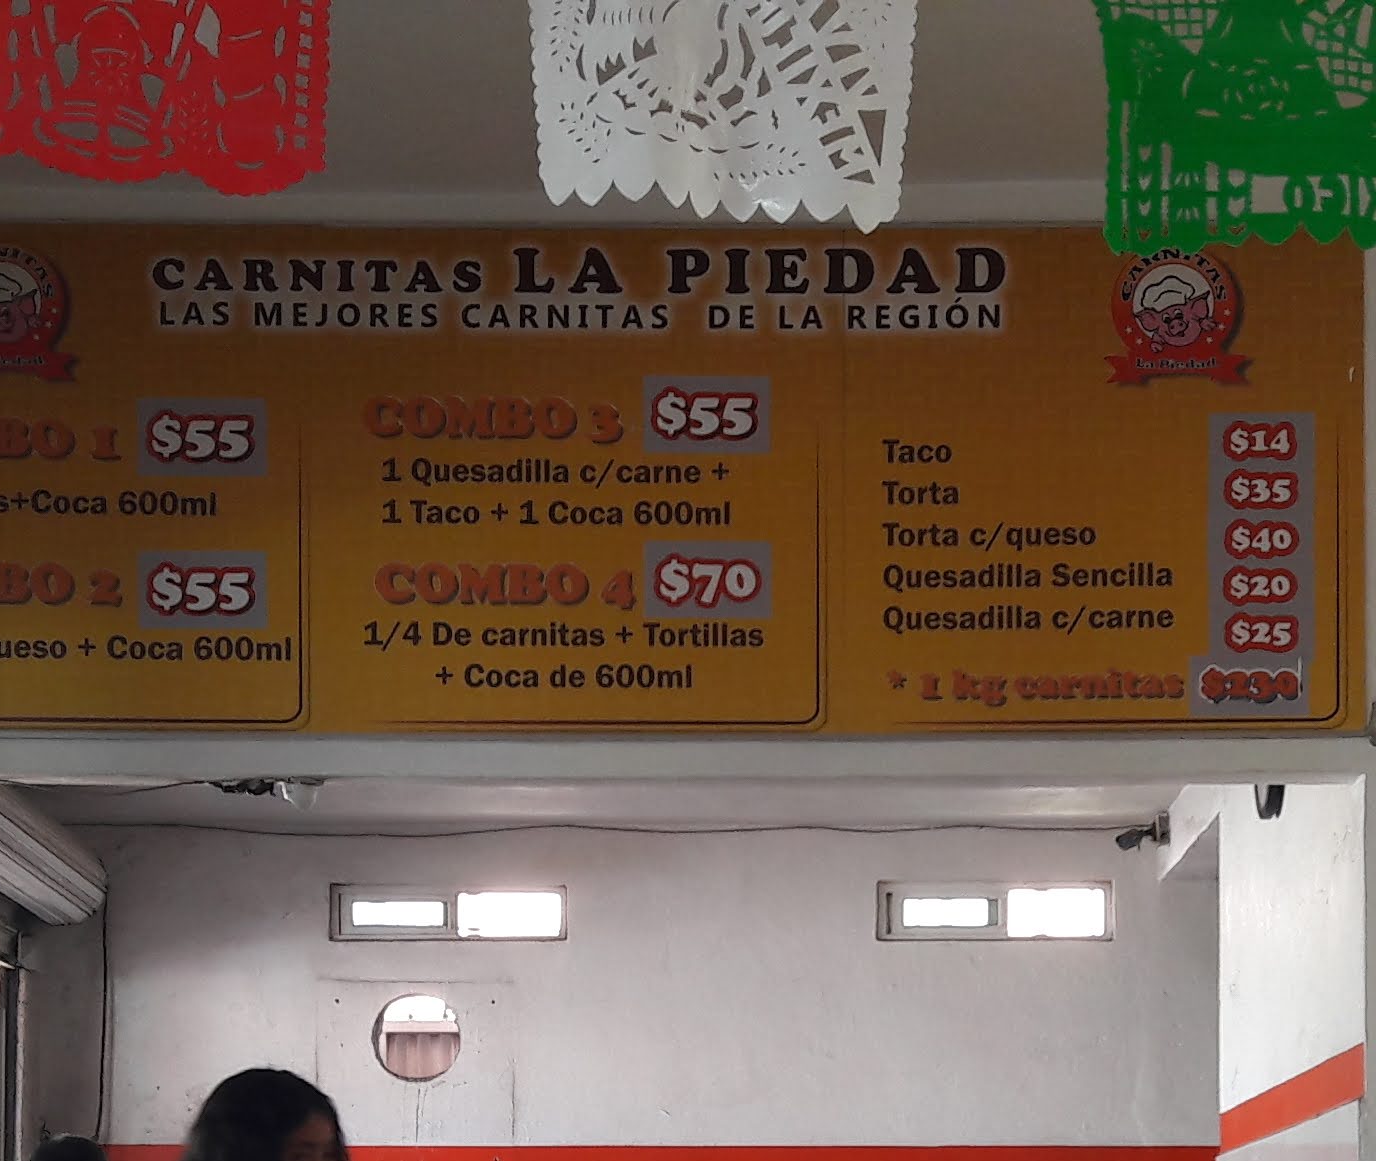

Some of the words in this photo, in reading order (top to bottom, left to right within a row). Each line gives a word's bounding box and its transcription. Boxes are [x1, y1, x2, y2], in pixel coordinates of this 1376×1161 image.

[152, 257, 484, 293] CARNITAS
[514, 248, 623, 294] LA
[667, 247, 1007, 296] PIEDAD
[159, 300, 231, 328] LAS
[253, 301, 440, 329] MEJORES
[461, 302, 670, 330] CARNITAS
[708, 303, 757, 330] DE
[779, 303, 823, 330] LA
[847, 296, 1003, 330] REGIÓN
[362, 396, 578, 440] COMBO
[589, 402, 625, 444] 3
[655, 389, 758, 439] $55
[90, 425, 123, 463] 1
[149, 411, 254, 461] $55
[882, 438, 953, 464] Taco
[1229, 426, 1291, 455] $14
[381, 457, 402, 482] 1
[411, 456, 570, 485] Quesadilla
[579, 459, 702, 489] c/carne
[882, 480, 960, 506] Torta
[1230, 474, 1292, 504] $35
[117, 491, 217, 517] 600ml
[381, 499, 402, 524] 1
[409, 499, 481, 525] Taco
[519, 500, 540, 525] 1
[548, 500, 624, 526] Coca
[633, 500, 732, 527] 600ml
[882, 522, 960, 548] Torta
[968, 521, 1097, 553] c/queso
[1230, 524, 1293, 554] $40
[88, 569, 123, 608] 2
[149, 564, 254, 614] $55
[374, 562, 590, 606] COMBO
[601, 568, 637, 610] 4
[658, 556, 758, 605] $70
[882, 563, 1042, 592] Quesadilla
[1051, 562, 1174, 589] Sencilla
[1229, 571, 1291, 600] $20
[363, 620, 422, 651] 1/4
[432, 621, 472, 648] De
[481, 621, 606, 648] carnitas
[643, 621, 765, 648] Tortillas
[882, 605, 1042, 635] Quesadilla
[1051, 605, 1175, 636] c/carne
[1230, 618, 1292, 647] $25
[106, 635, 184, 662] Coca
[192, 635, 292, 662] 600ml
[463, 663, 540, 689] Coca
[549, 662, 586, 688] de
[594, 663, 693, 689] 600ml
[919, 671, 944, 701] 1
[950, 667, 1007, 708] kg
[1013, 666, 1186, 702] carnitas
